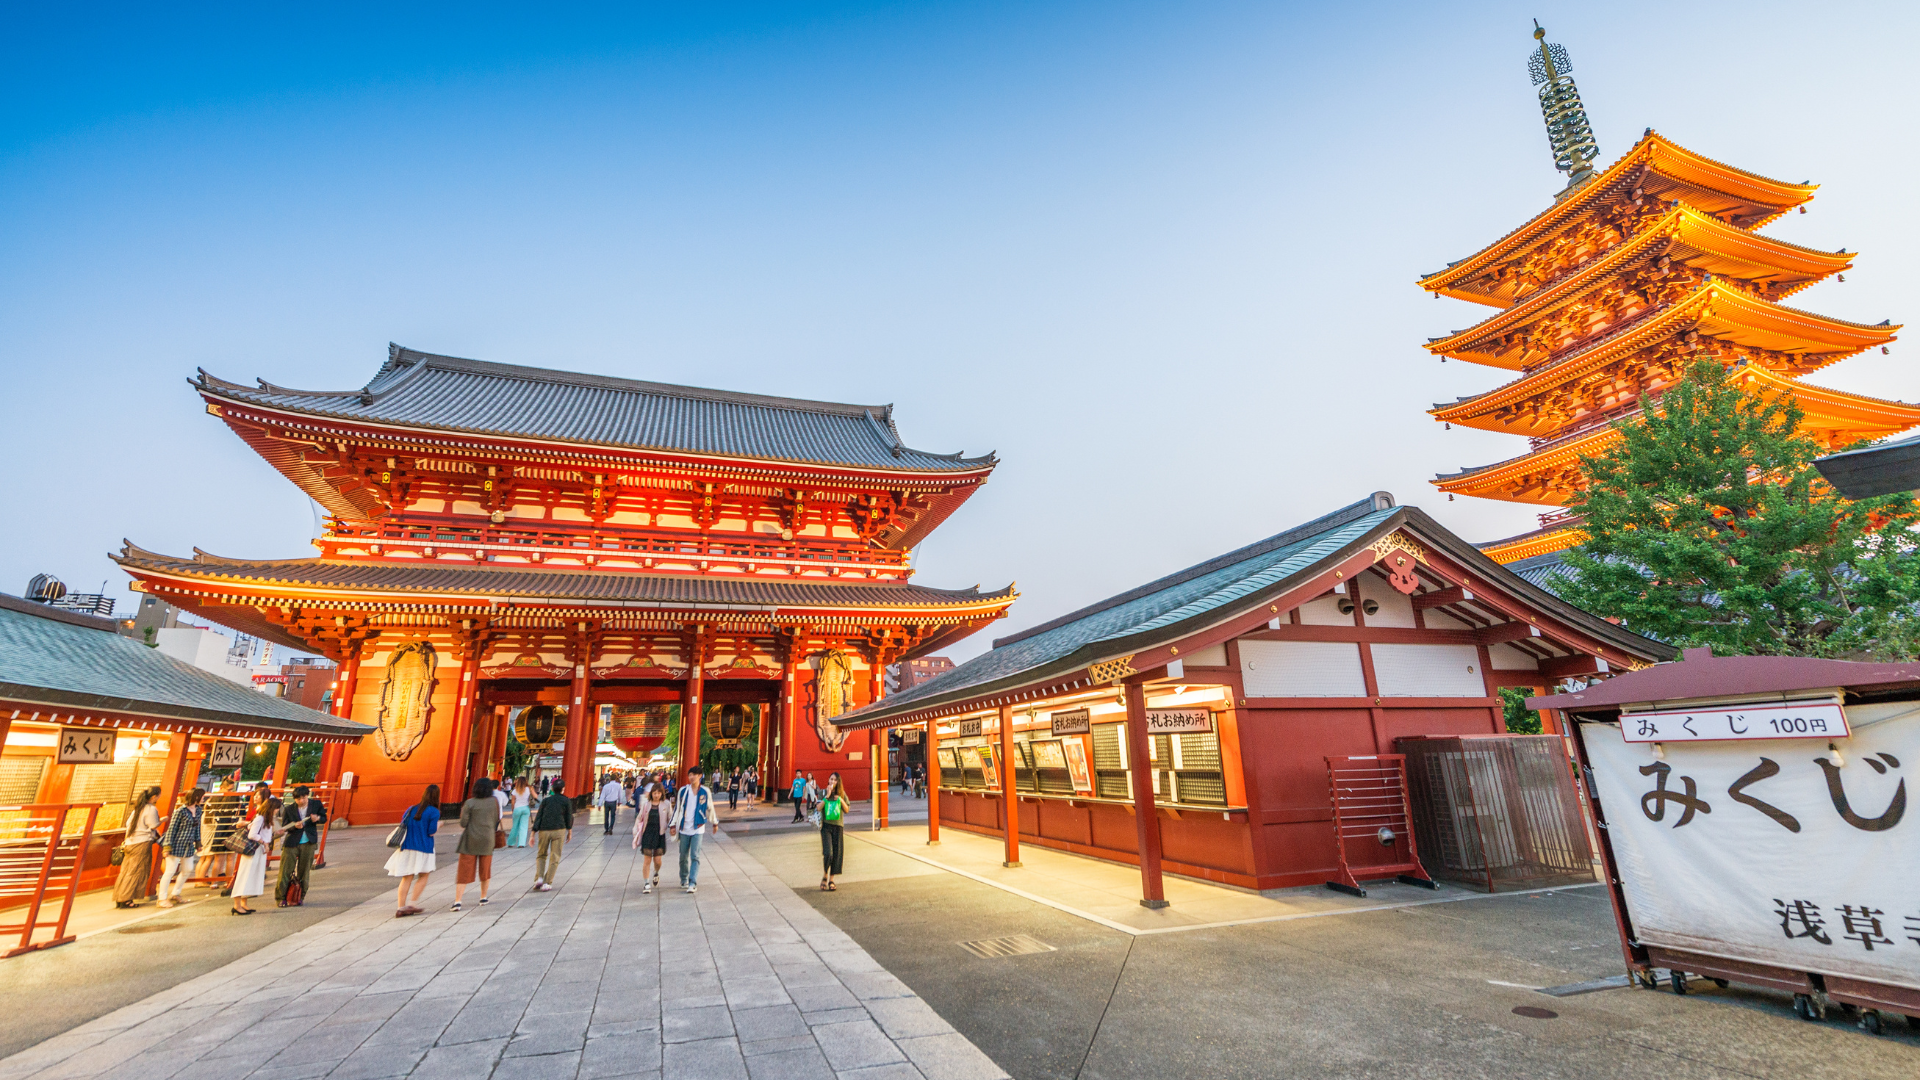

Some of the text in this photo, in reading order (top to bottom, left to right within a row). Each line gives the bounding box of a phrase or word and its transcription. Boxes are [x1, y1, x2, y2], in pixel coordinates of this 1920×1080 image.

[1054, 713, 1088, 731] 古札お納め所
[1637, 714, 1827, 738] みくじ 100円
[64, 736, 110, 755] みくじ
[215, 746, 241, 761] みくじ
[1638, 752, 1907, 834] みくじ
